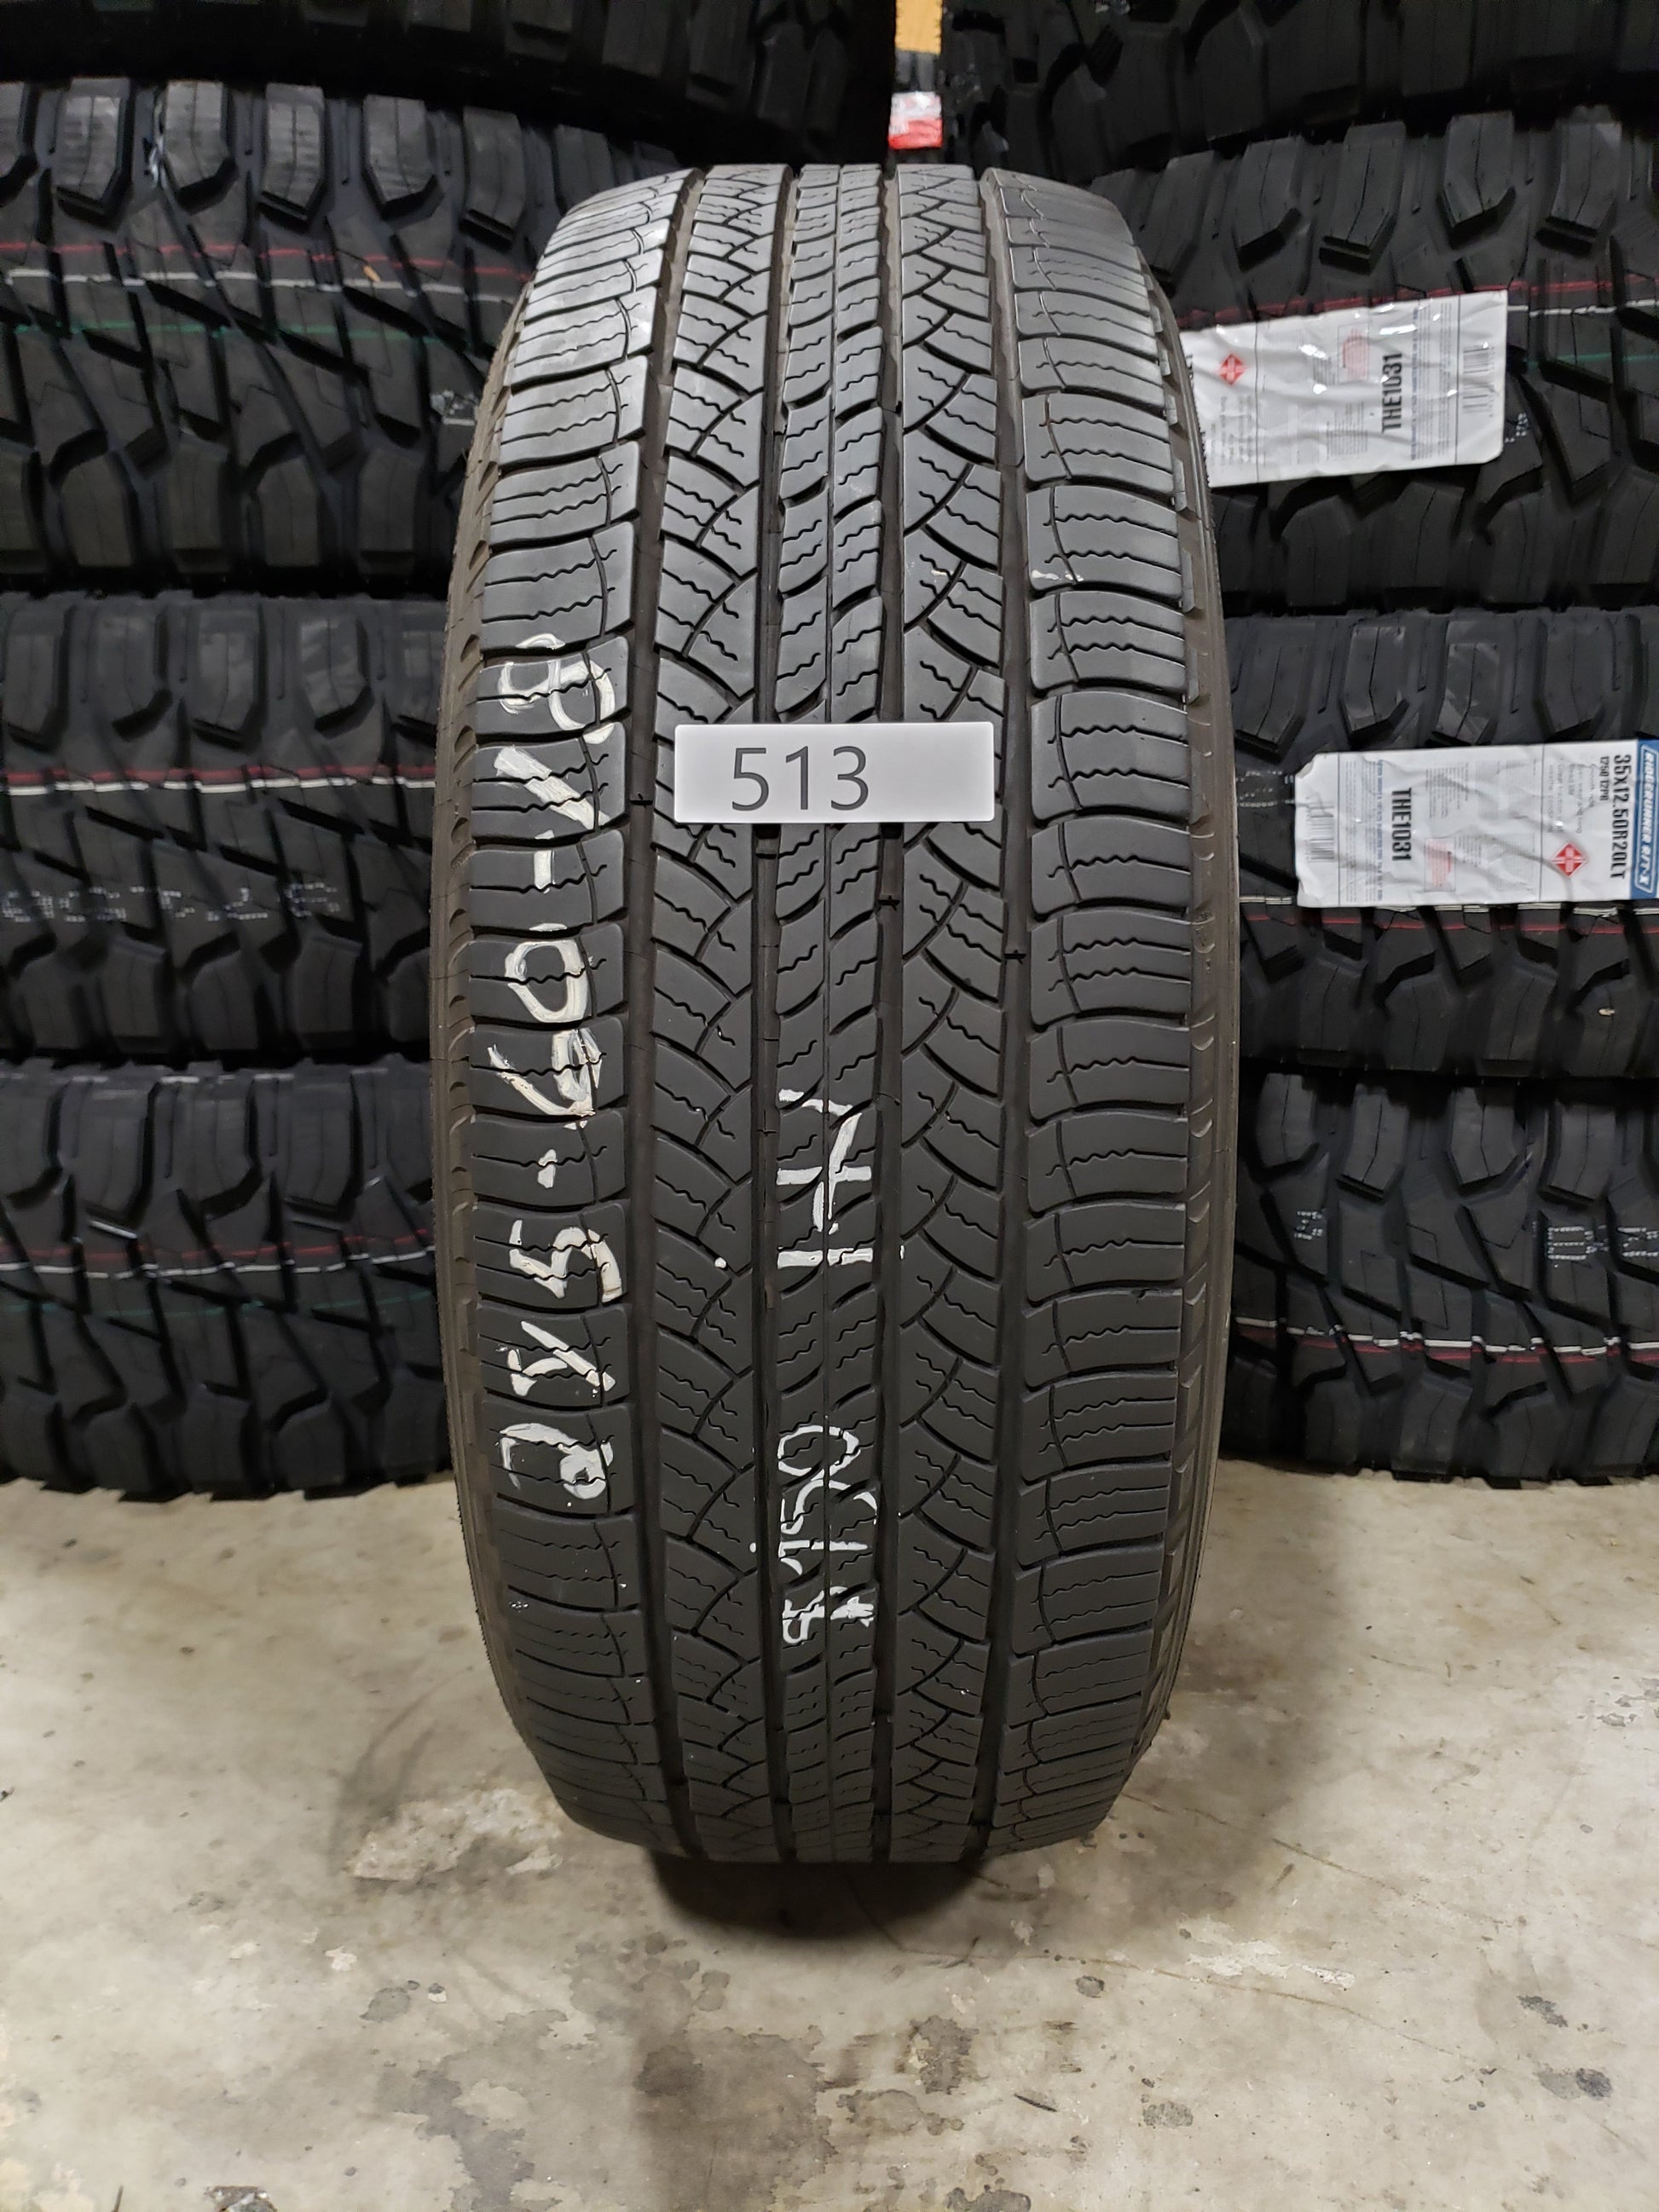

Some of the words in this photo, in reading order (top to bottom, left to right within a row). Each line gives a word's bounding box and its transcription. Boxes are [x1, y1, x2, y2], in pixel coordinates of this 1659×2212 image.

[1381, 352, 1402, 433] THE1031
[731, 745, 869, 811] 513
[1391, 787, 1412, 861] THE1031
[1610, 754, 1632, 880] 35x12.50R20LT
